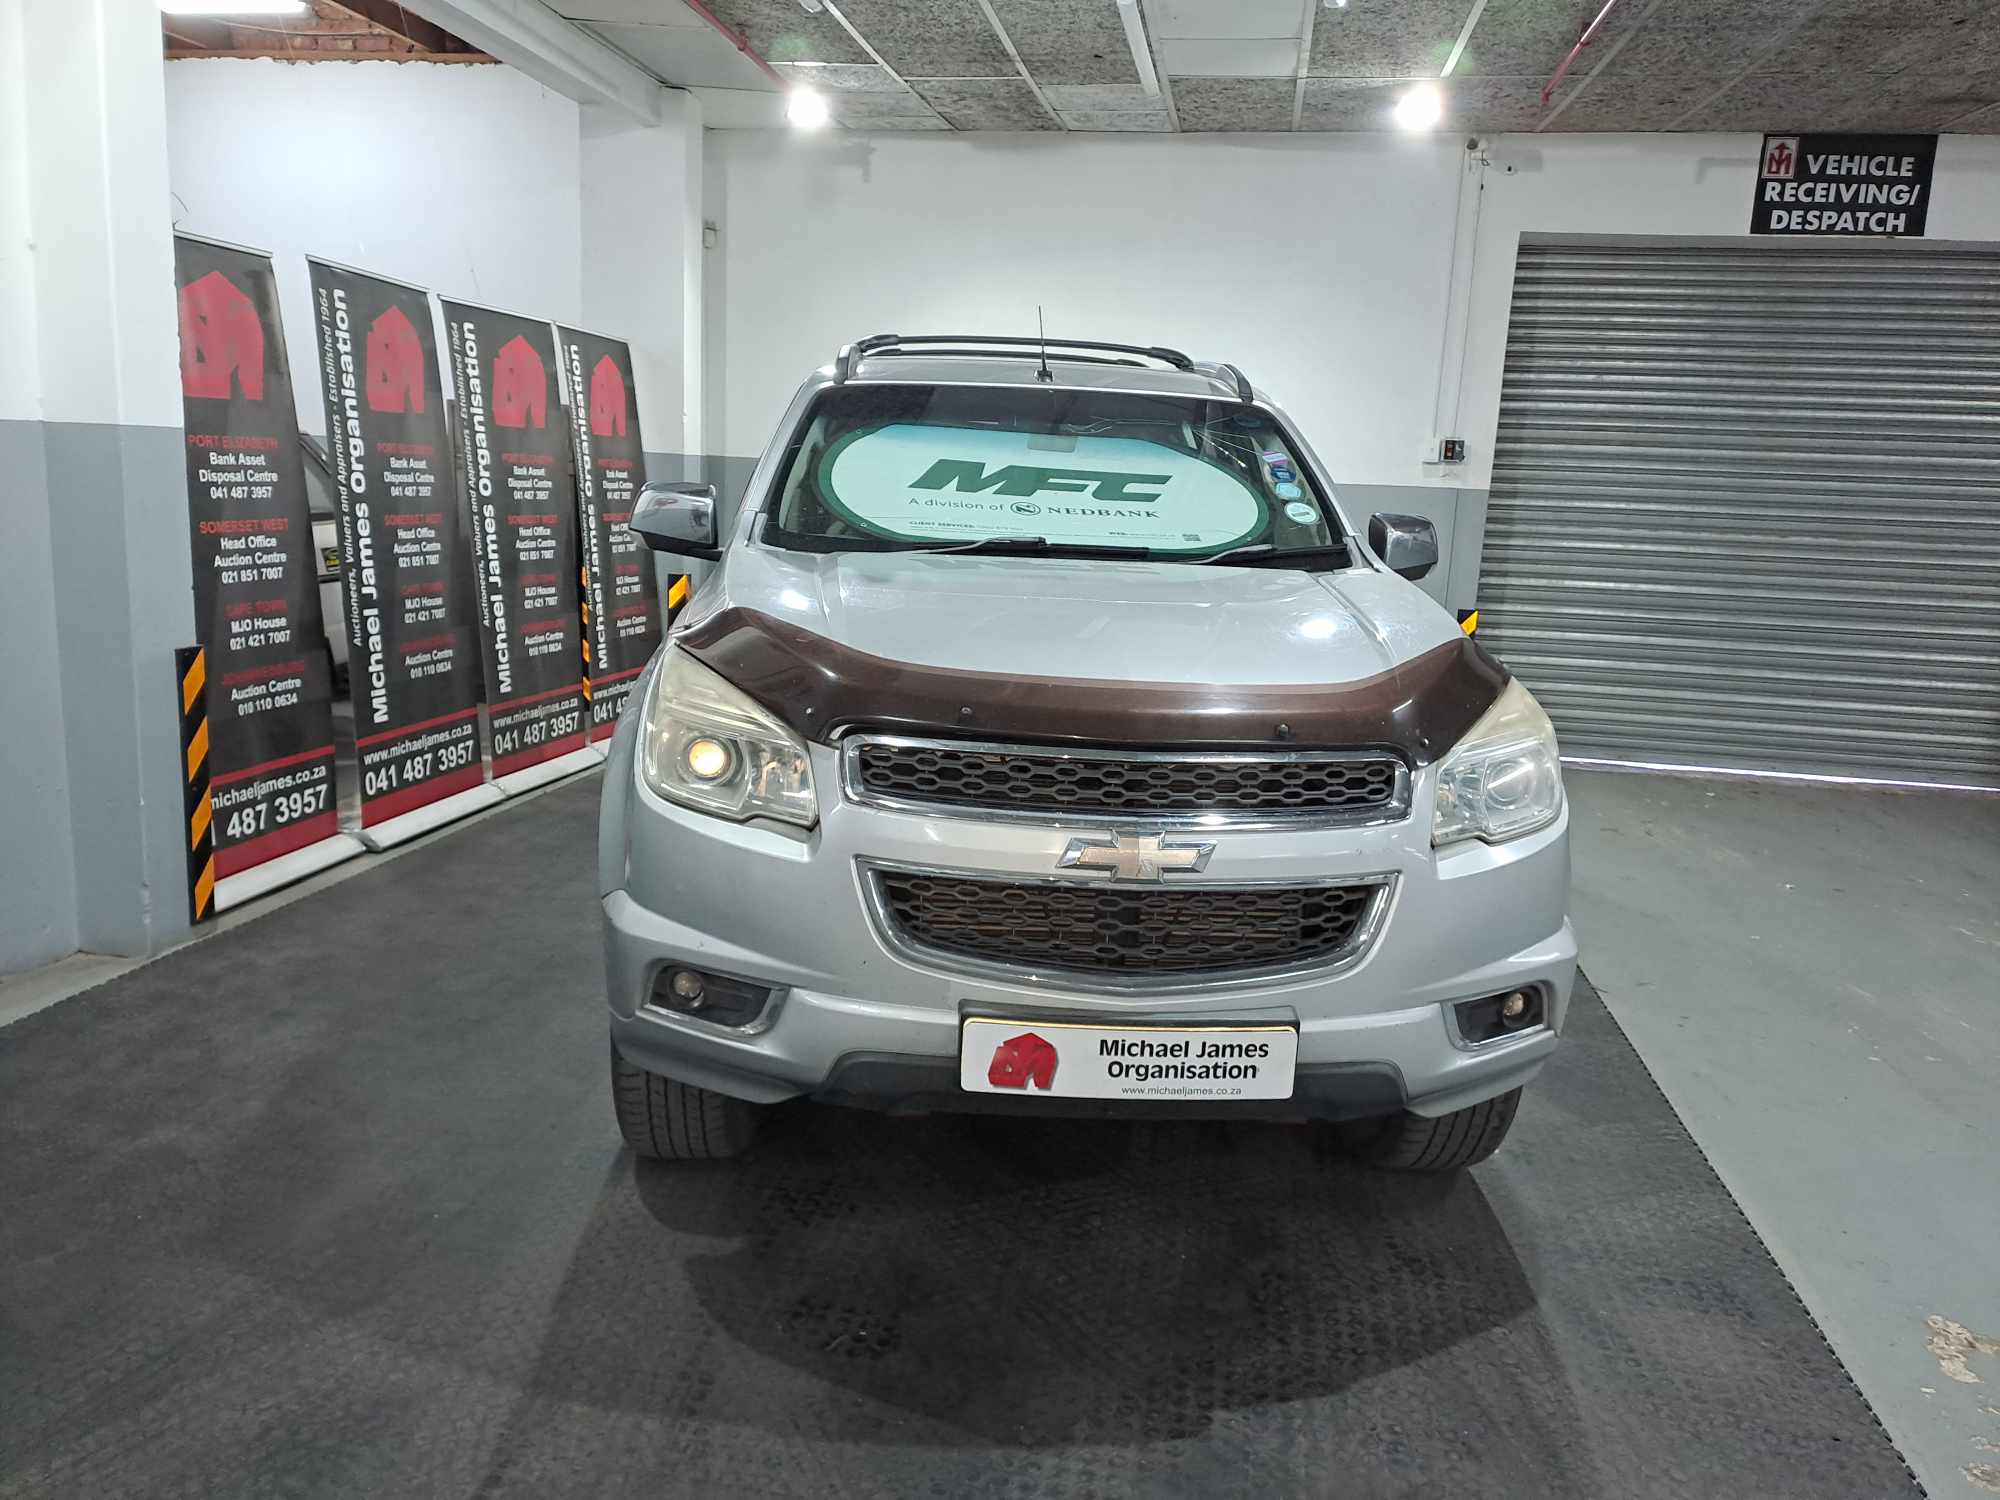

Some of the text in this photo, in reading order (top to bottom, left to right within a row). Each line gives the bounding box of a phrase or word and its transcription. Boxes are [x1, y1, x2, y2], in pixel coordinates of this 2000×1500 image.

[1806, 154, 1916, 177] VEHICLE
[1764, 182, 1921, 206] RECEIVING/
[1770, 209, 1907, 233] DESPATCH
[318, 287, 330, 321] 1964
[322, 325, 338, 402] Established
[209, 452, 266, 465] Bank Asset
[332, 414, 348, 484] Appraisers
[199, 469, 279, 484] Disposal Centre
[907, 458, 1173, 503] MFC
[210, 486, 273, 499] 041 487 3957
[338, 486, 349, 512] and
[333, 288, 389, 723] Michael James Organisation
[463, 322, 512, 693] Michael James Organisation
[570, 344, 608, 669] Michael James Organisation
[908, 497, 1160, 519] A division of NEDBANK
[220, 535, 277, 550] Head Office
[214, 552, 287, 567] Auction Centre
[221, 566, 284, 584] 021 851 7007
[349, 567, 363, 647] Auctioneers,
[231, 617, 288, 634] MJO House
[229, 629, 291, 650] 021 421 7007
[231, 678, 302, 701] Auction Centre
[593, 701, 613, 723] 041
[495, 711, 579, 755] 041 487 3957
[363, 724, 472, 766] www.michaeljames.co.za
[365, 740, 474, 796] 041 487 3957
[227, 803, 267, 838] 487
[274, 783, 328, 823] 3957
[1099, 1039, 1269, 1058] Michael James
[1107, 1060, 1258, 1082] Organisation
[1121, 1086, 1242, 1097] www.michaeljames.co.za
